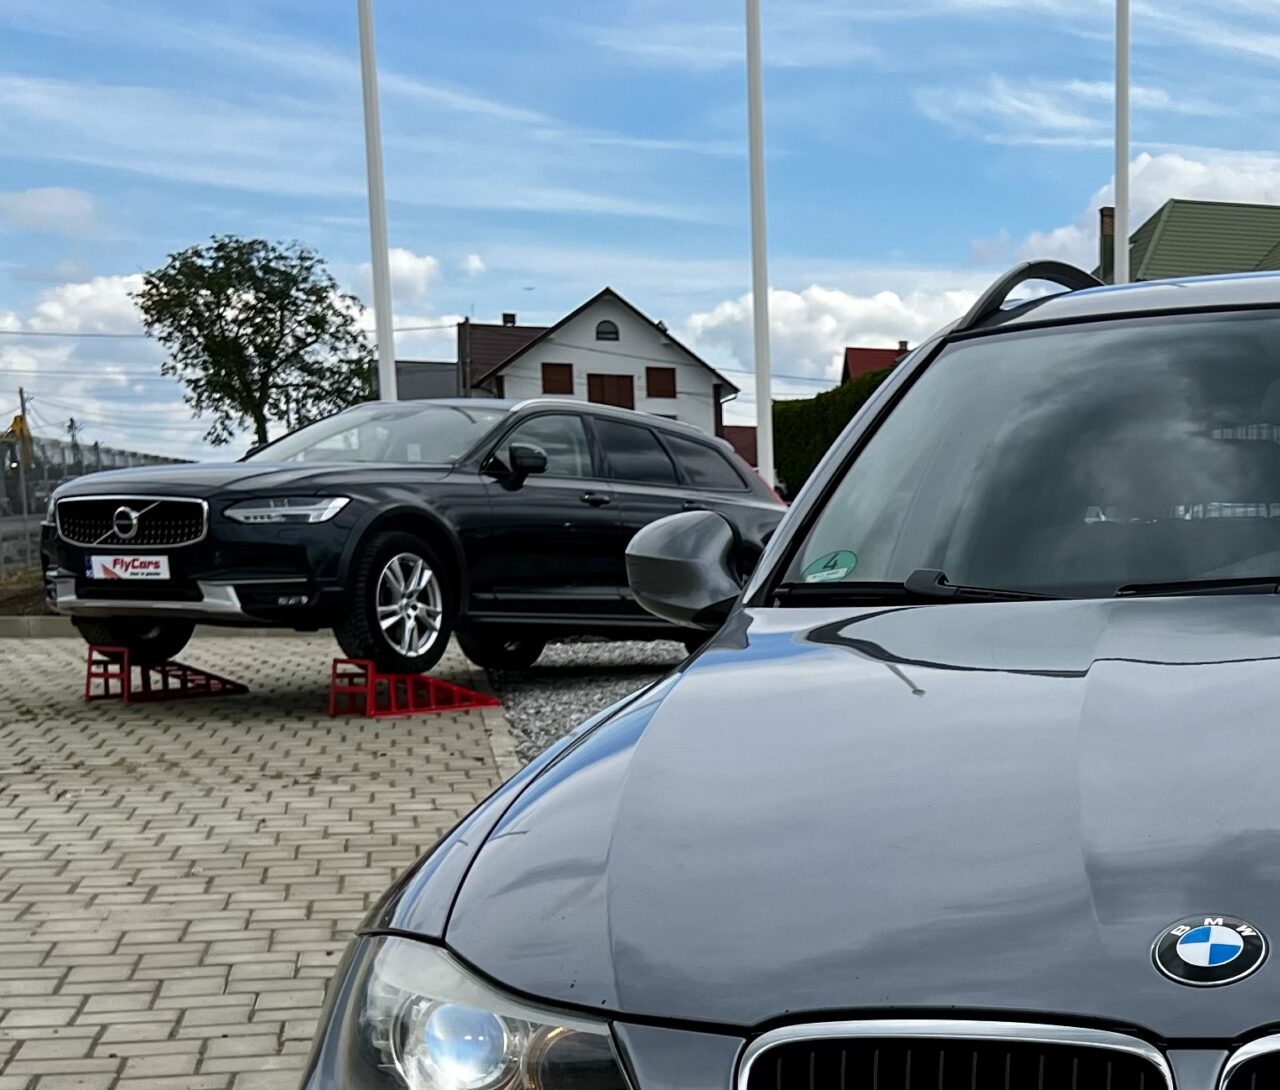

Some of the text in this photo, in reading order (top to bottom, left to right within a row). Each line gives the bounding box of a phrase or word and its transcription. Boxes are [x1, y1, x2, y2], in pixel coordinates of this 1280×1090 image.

[112, 558, 161, 571] FlyCars
[822, 552, 841, 569] 4
[1170, 917, 1257, 937] BMW
